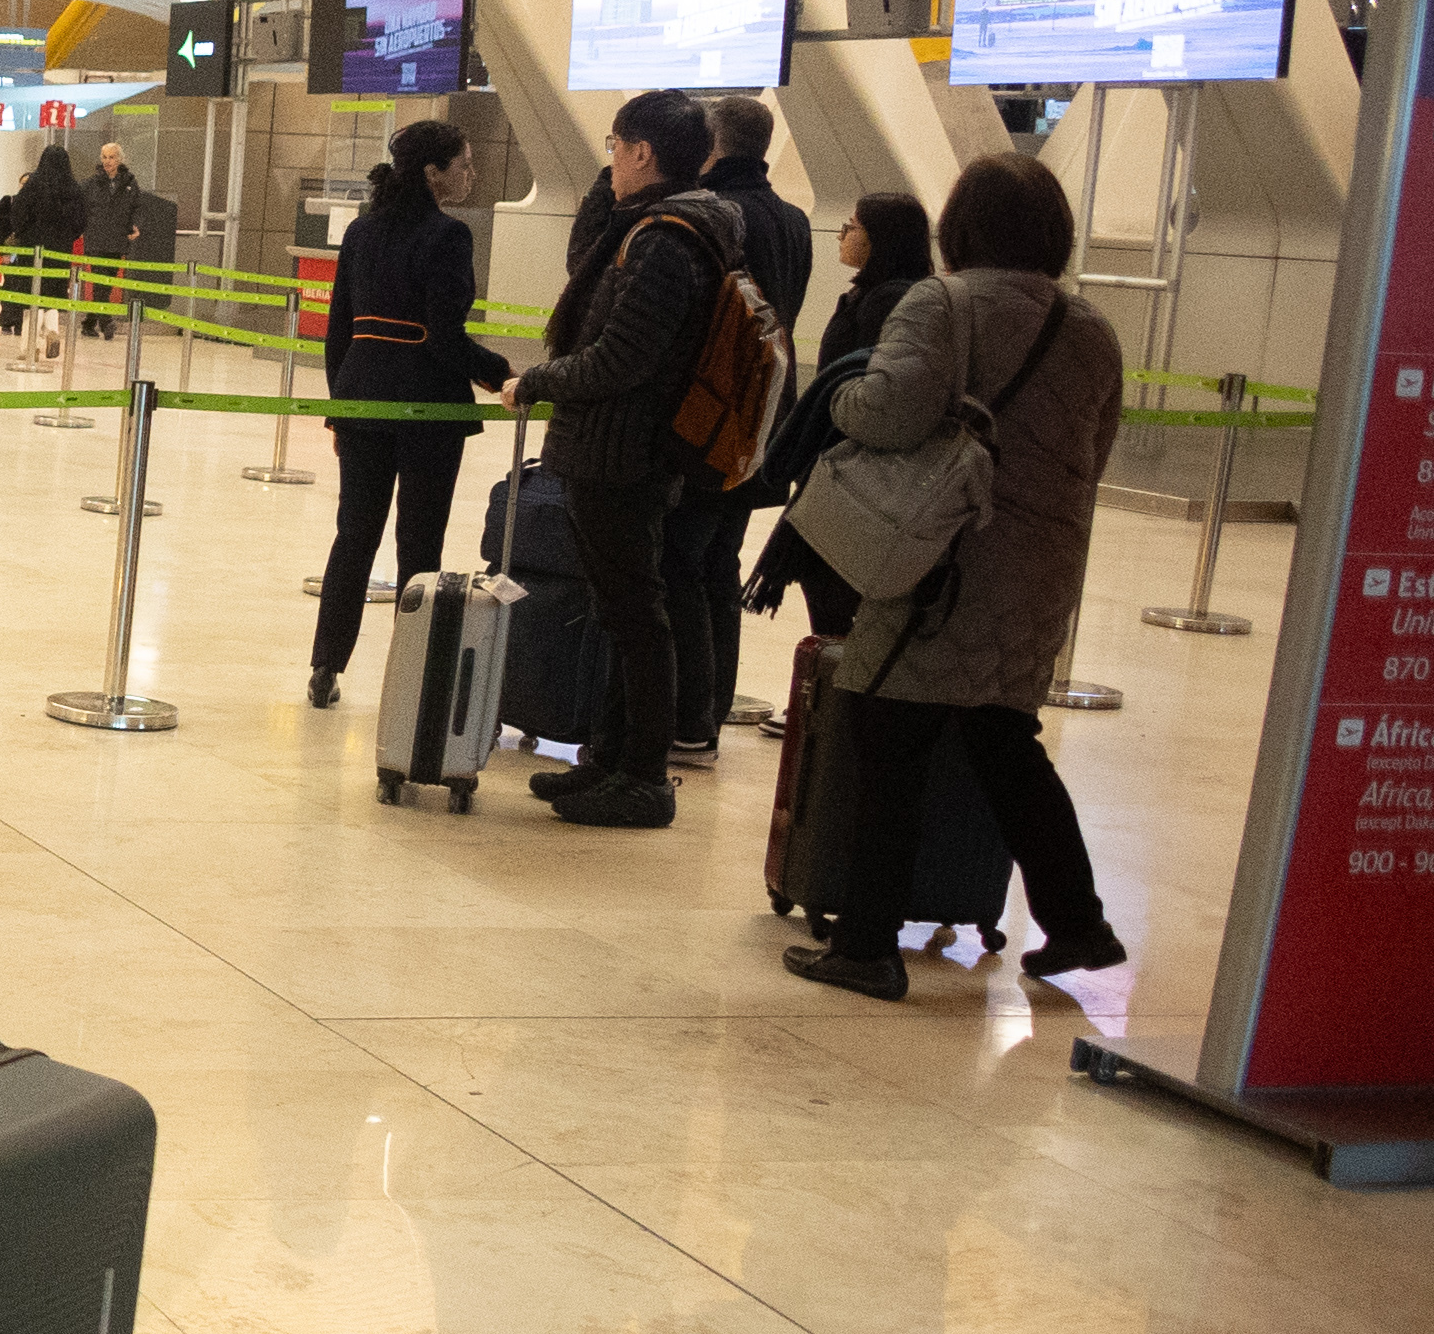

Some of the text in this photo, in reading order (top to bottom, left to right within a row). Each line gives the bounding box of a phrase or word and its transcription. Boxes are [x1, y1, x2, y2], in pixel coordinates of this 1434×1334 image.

[1383, 657, 1429, 680] 870
[1359, 780, 1433, 810] Africa,
[1349, 851, 1394, 874] 900
